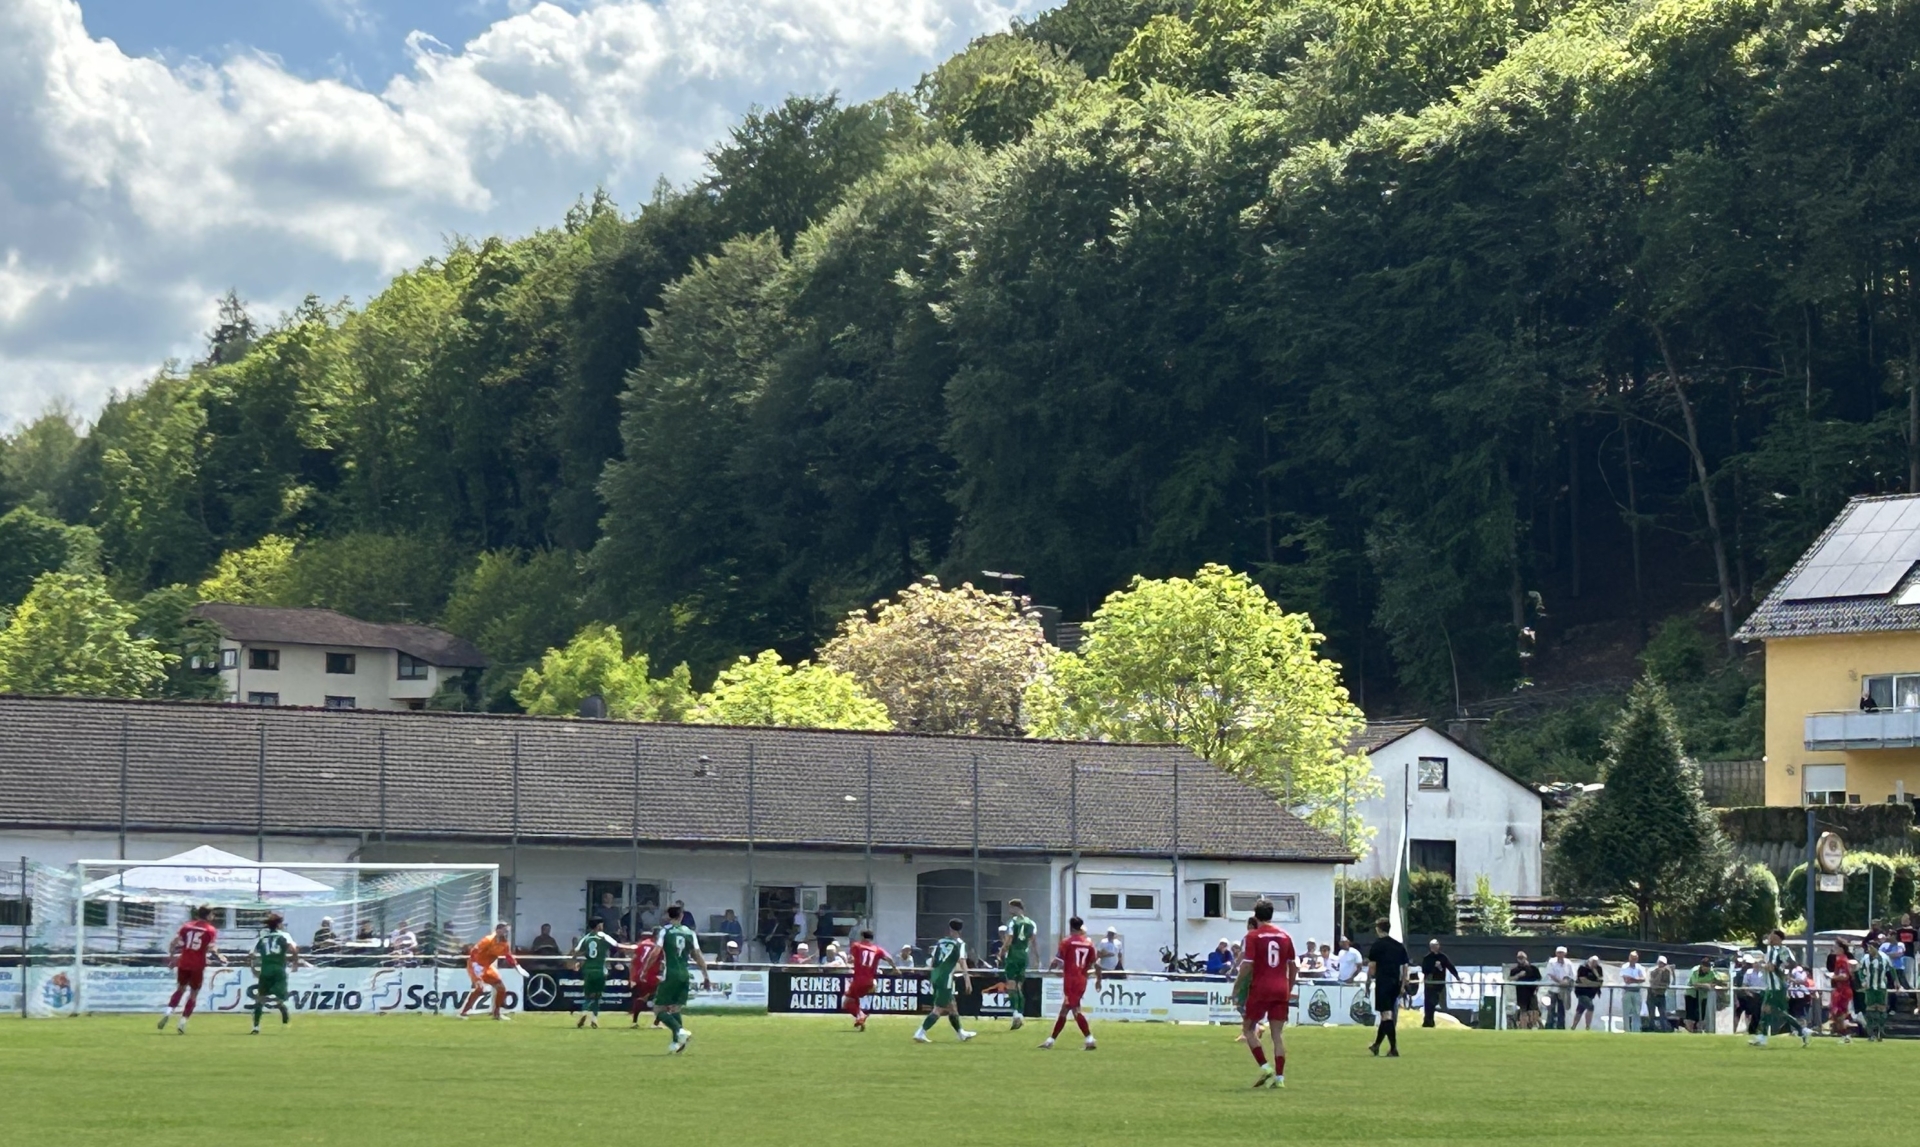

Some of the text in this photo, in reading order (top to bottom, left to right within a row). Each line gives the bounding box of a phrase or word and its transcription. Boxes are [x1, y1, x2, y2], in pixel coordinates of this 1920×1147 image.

[1075, 947, 1089, 968] 17
[1267, 940, 1280, 968] 6
[790, 976, 841, 992] KEINER
[895, 978, 918, 994] EIN
[1100, 983, 1147, 1006] dhr
[790, 994, 837, 1010] ALLEIN
